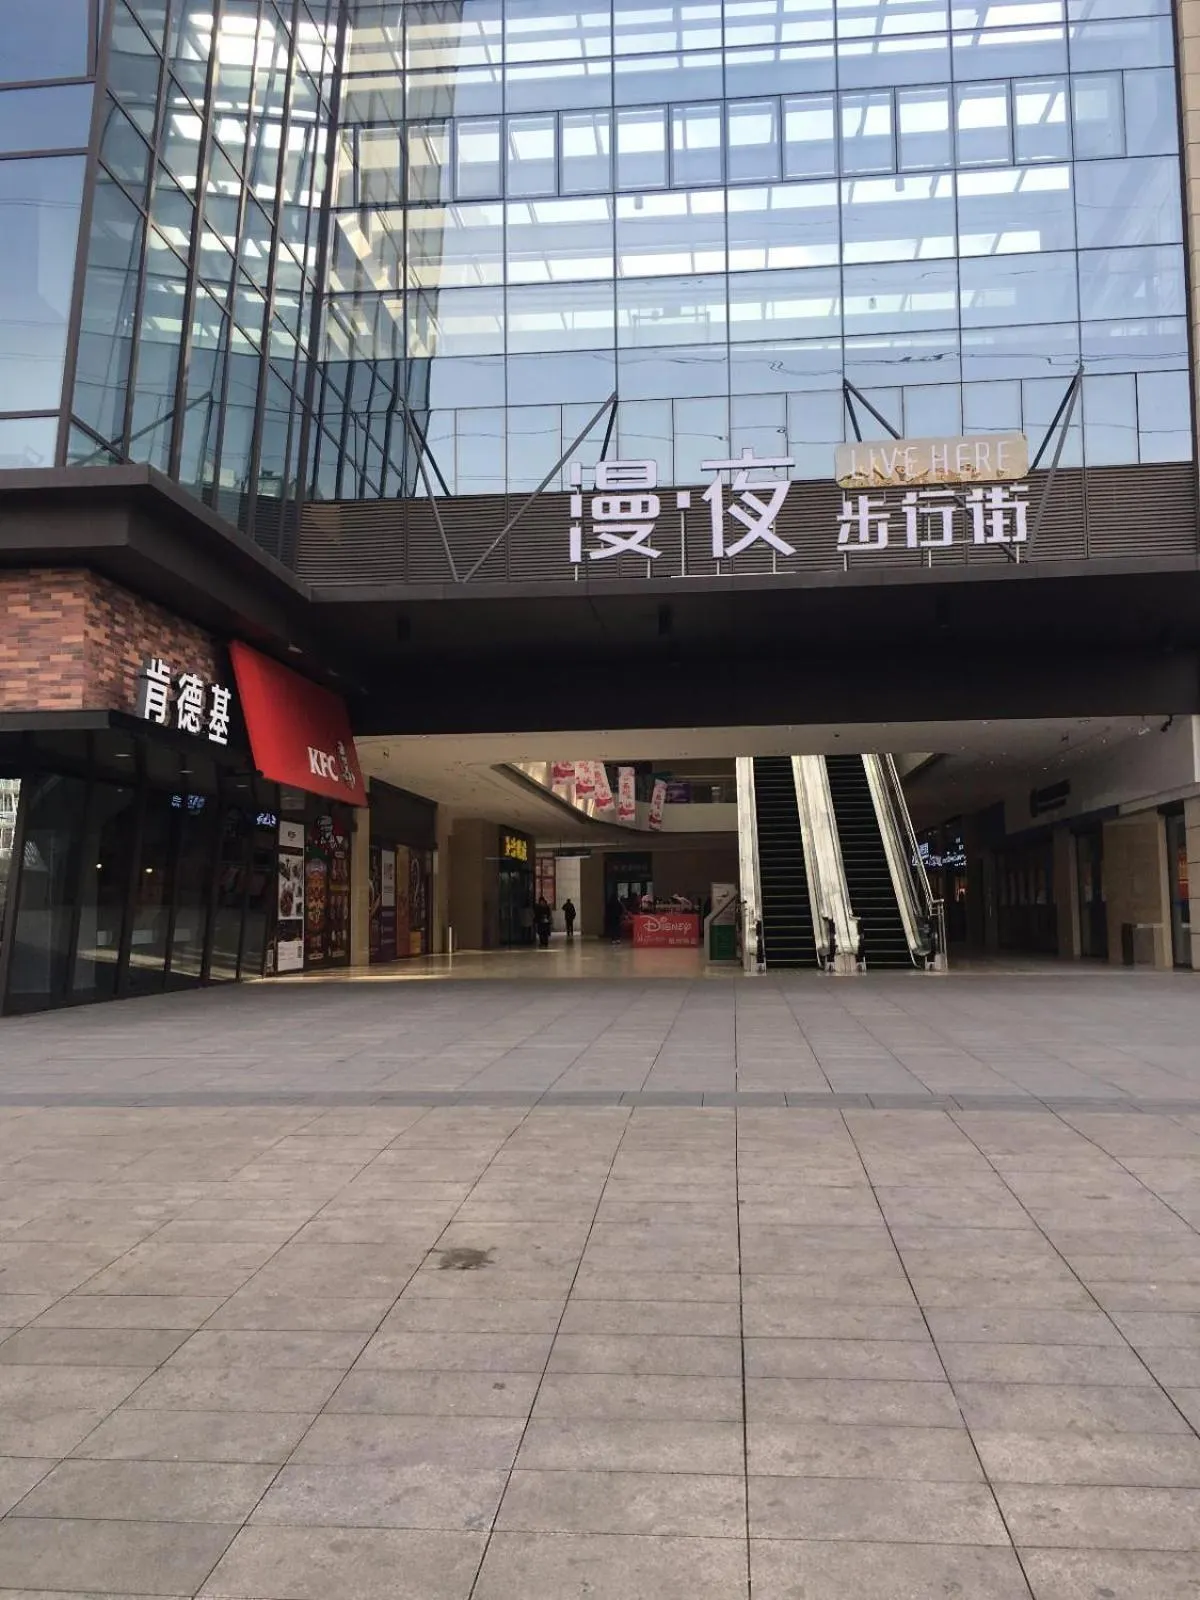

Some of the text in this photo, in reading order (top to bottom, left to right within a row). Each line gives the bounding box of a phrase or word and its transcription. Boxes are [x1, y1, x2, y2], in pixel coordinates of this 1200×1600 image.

[850, 440, 1010, 480] LIVE HERE
[836, 484, 1030, 551] 步行街
[144, 658, 232, 745] 肯德基
[307, 746, 339, 781] KFC
